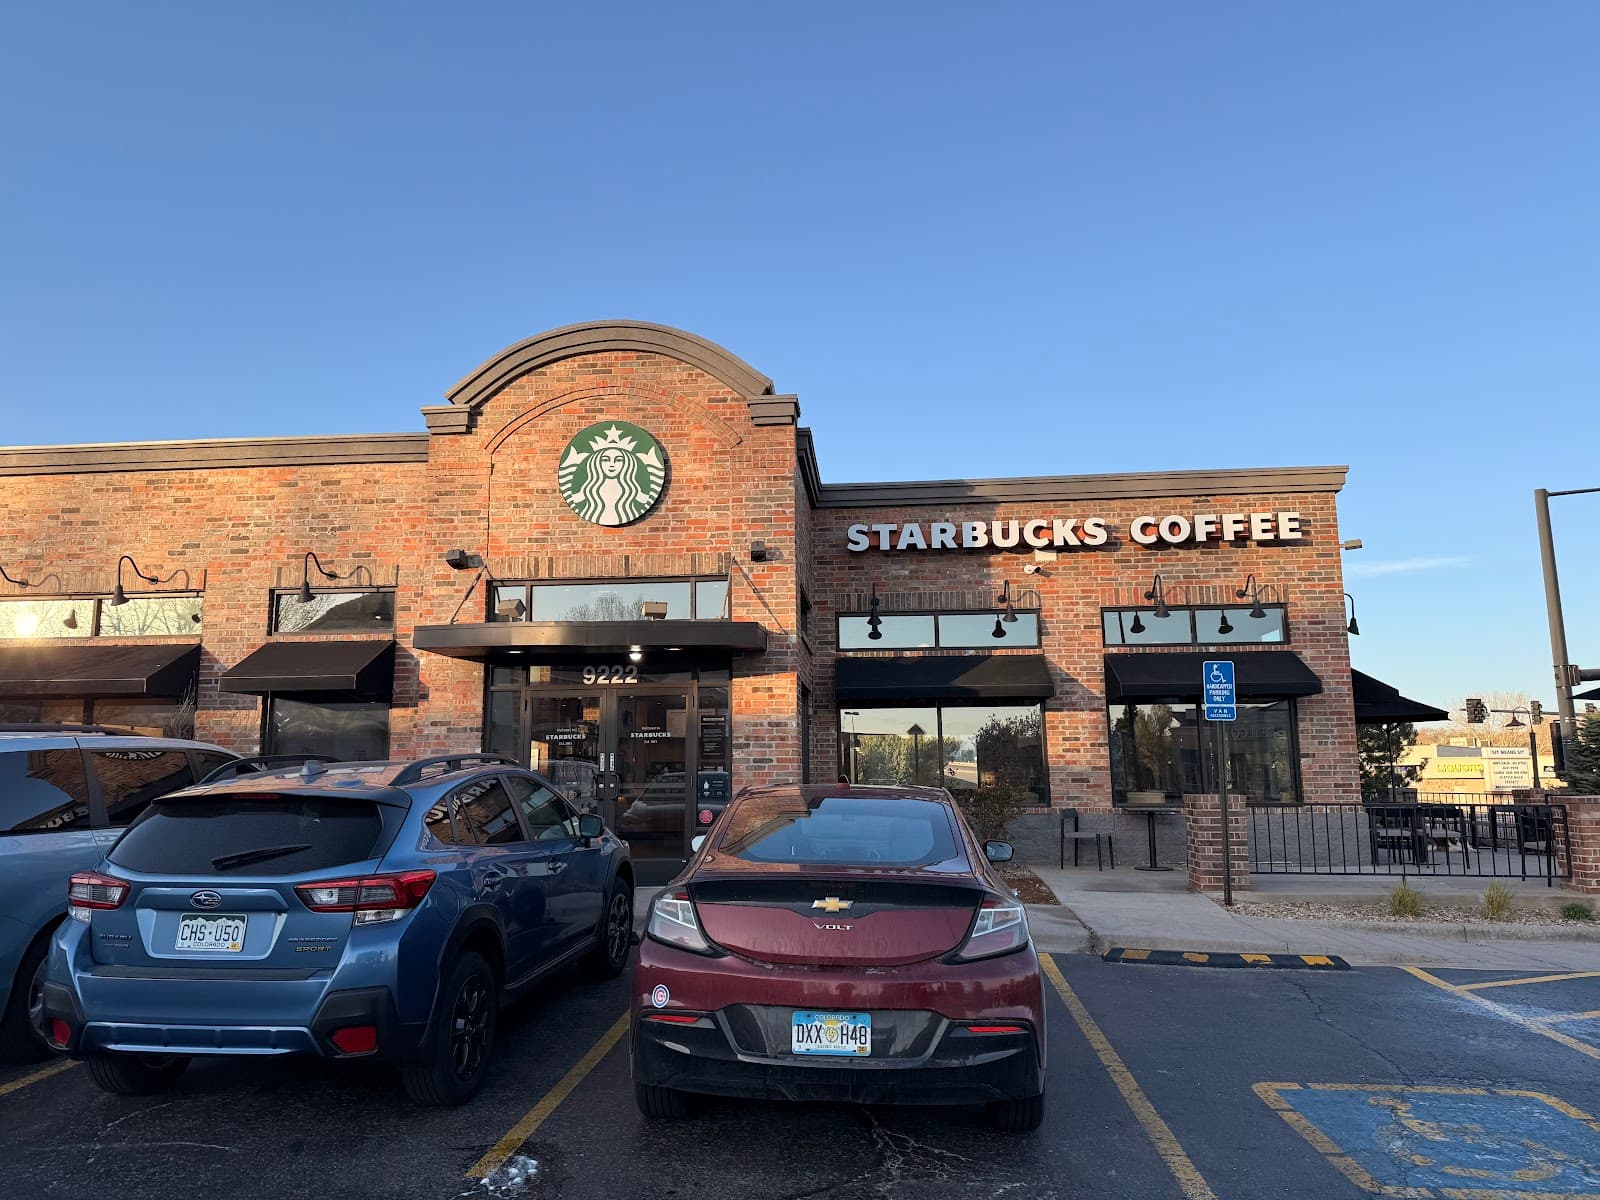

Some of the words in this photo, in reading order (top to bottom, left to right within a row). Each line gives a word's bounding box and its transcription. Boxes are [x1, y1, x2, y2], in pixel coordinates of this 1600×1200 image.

[847, 517, 1108, 551] STARBUCKS
[1130, 512, 1303, 544] COFFEE
[582, 665, 638, 685] 9222
[811, 920, 853, 930] VOLT
[796, 1024, 822, 1043] DXX
